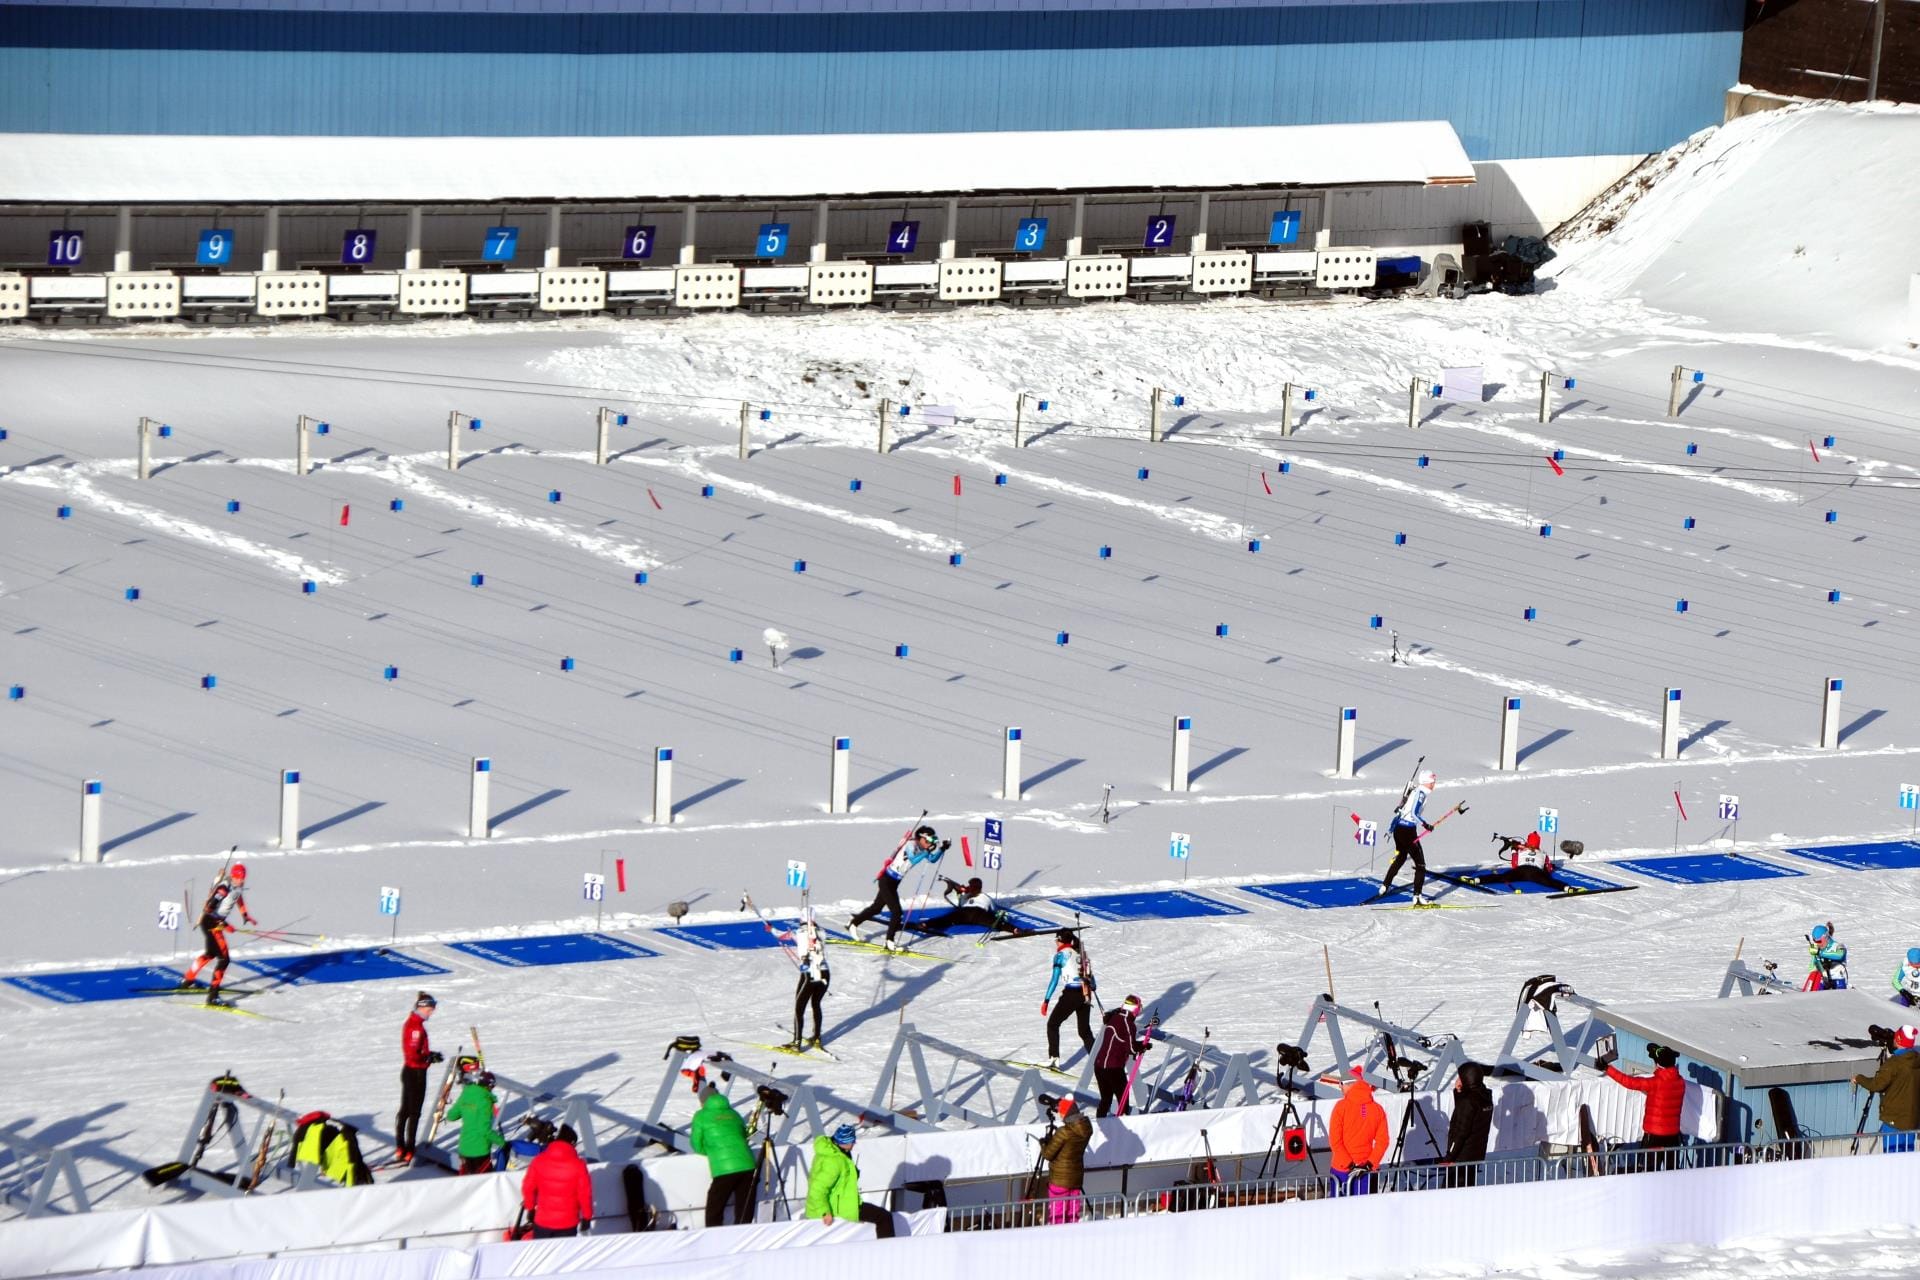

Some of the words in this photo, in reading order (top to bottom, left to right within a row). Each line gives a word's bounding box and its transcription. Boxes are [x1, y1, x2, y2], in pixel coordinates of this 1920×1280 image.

[896, 225, 910, 249] 4
[1025, 222, 1038, 246] 3
[1153, 219, 1167, 243] 2
[1282, 216, 1290, 239] 1
[53, 235, 82, 261] 10
[208, 234, 224, 260] 9
[352, 234, 366, 259] 8
[495, 231, 510, 256] 7
[632, 230, 647, 255] 6
[766, 228, 780, 252] 5
[1900, 792, 1917, 809] 11
[1719, 803, 1737, 820] 12
[1540, 816, 1556, 833] 13
[1358, 829, 1375, 846] 14
[1171, 841, 1189, 859] 15
[984, 852, 1000, 870] 16
[788, 869, 806, 887] 17
[584, 882, 602, 901] 18
[380, 896, 398, 915] 19
[158, 911, 178, 930] 20
